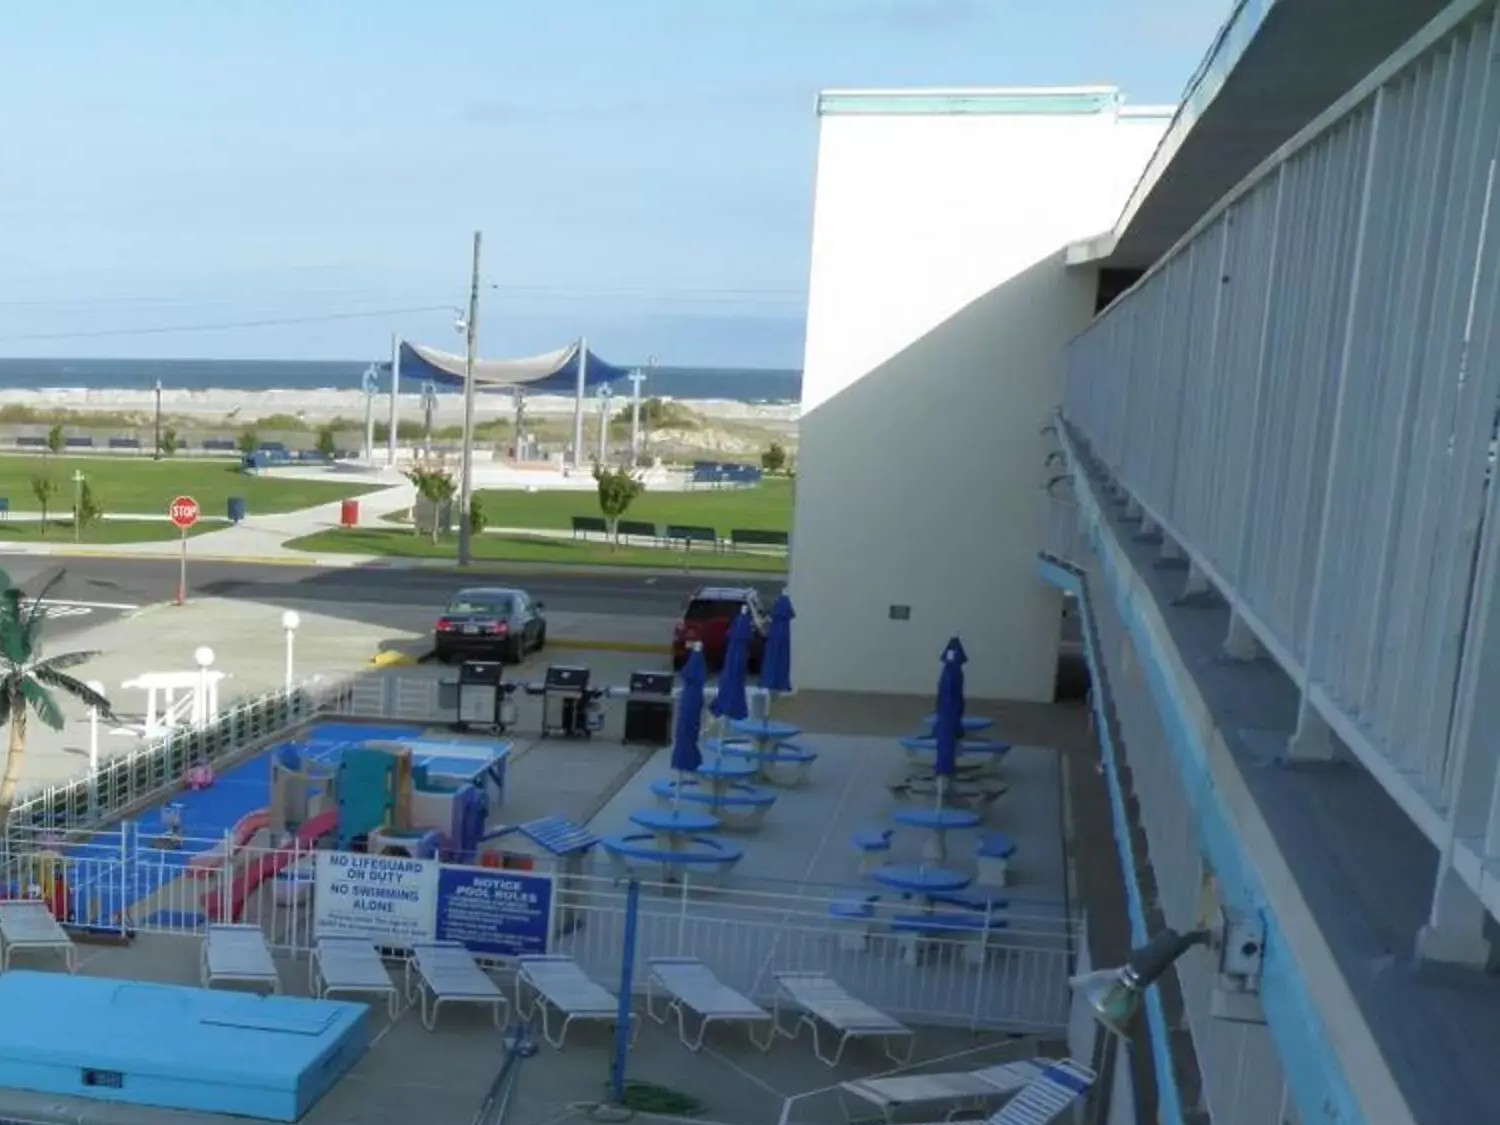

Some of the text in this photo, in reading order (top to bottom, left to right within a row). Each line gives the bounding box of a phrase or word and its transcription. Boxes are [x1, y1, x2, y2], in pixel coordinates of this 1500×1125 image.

[172, 505, 197, 518] STOP
[329, 854, 424, 873] NO LIFEGUARD
[347, 868, 403, 883] ON DUTY
[473, 877, 523, 891] NOTICE
[330, 883, 419, 902] NO SWIMMING
[456, 885, 489, 898] POOL
[353, 899, 394, 913] ALONE
